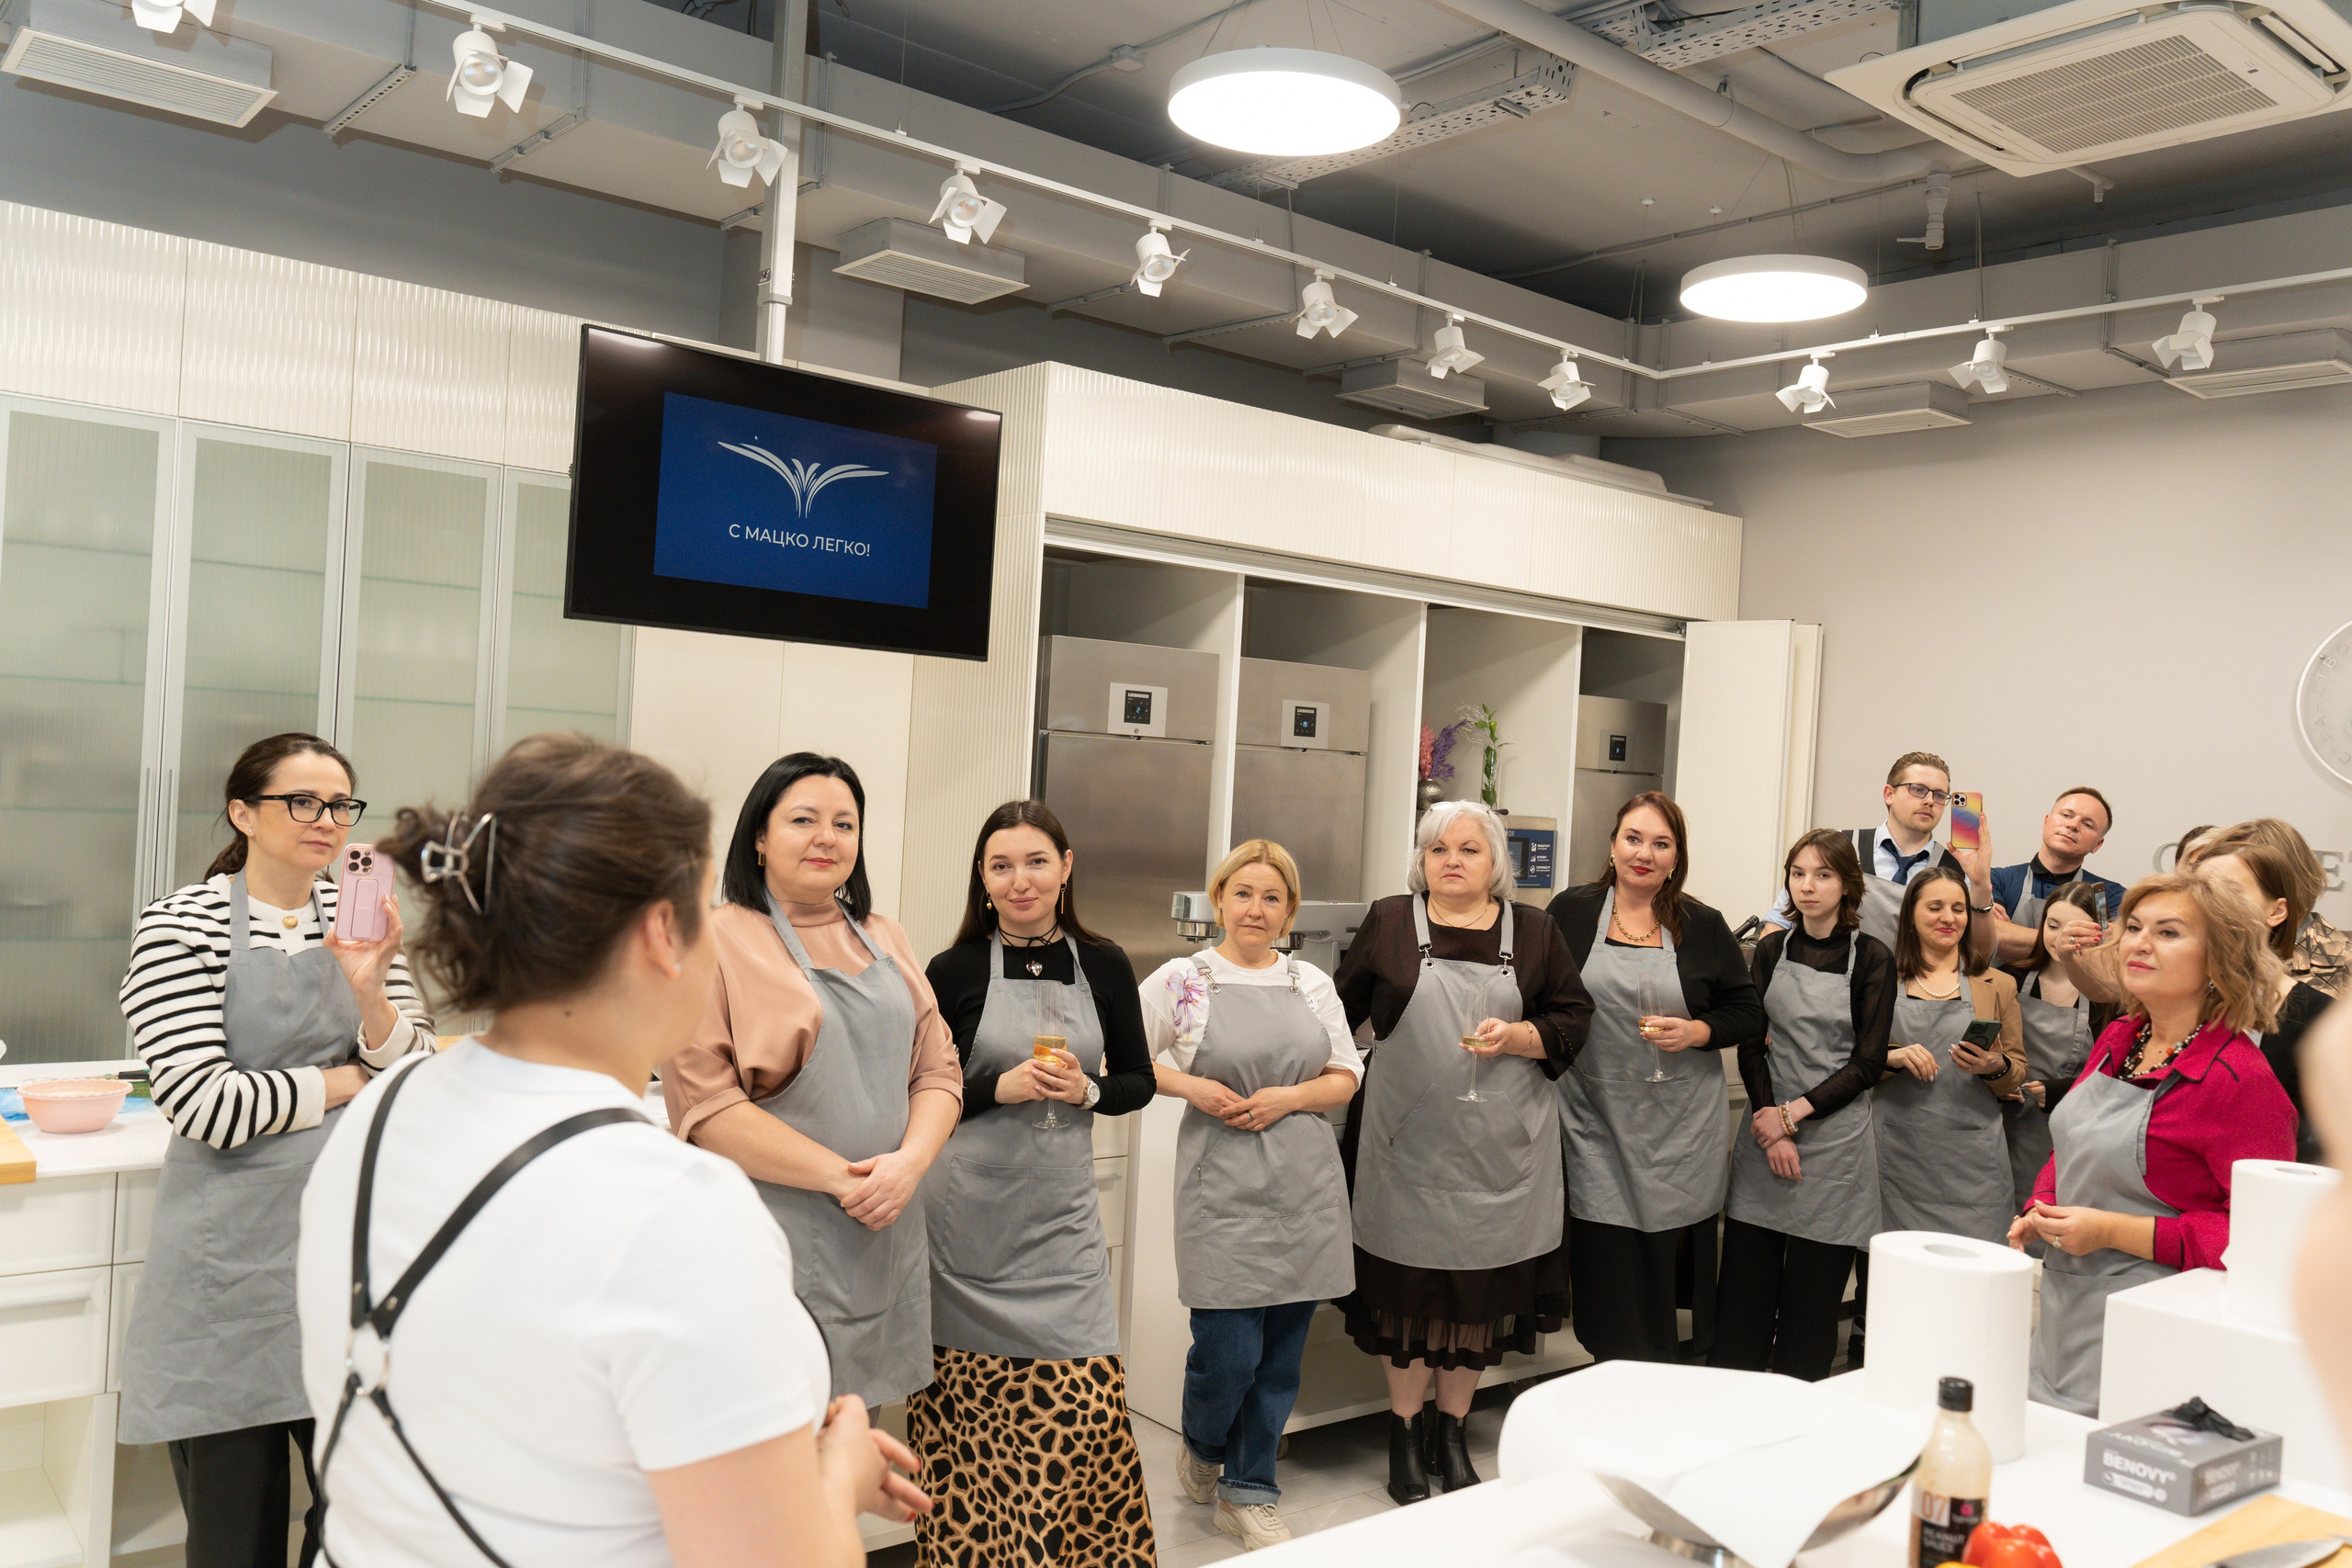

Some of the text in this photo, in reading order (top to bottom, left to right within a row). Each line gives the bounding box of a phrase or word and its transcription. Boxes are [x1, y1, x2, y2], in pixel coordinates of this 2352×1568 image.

[729, 524, 870, 557] С МАЦКО ЛЕГКО!
[1921, 1490, 1947, 1522] 07
